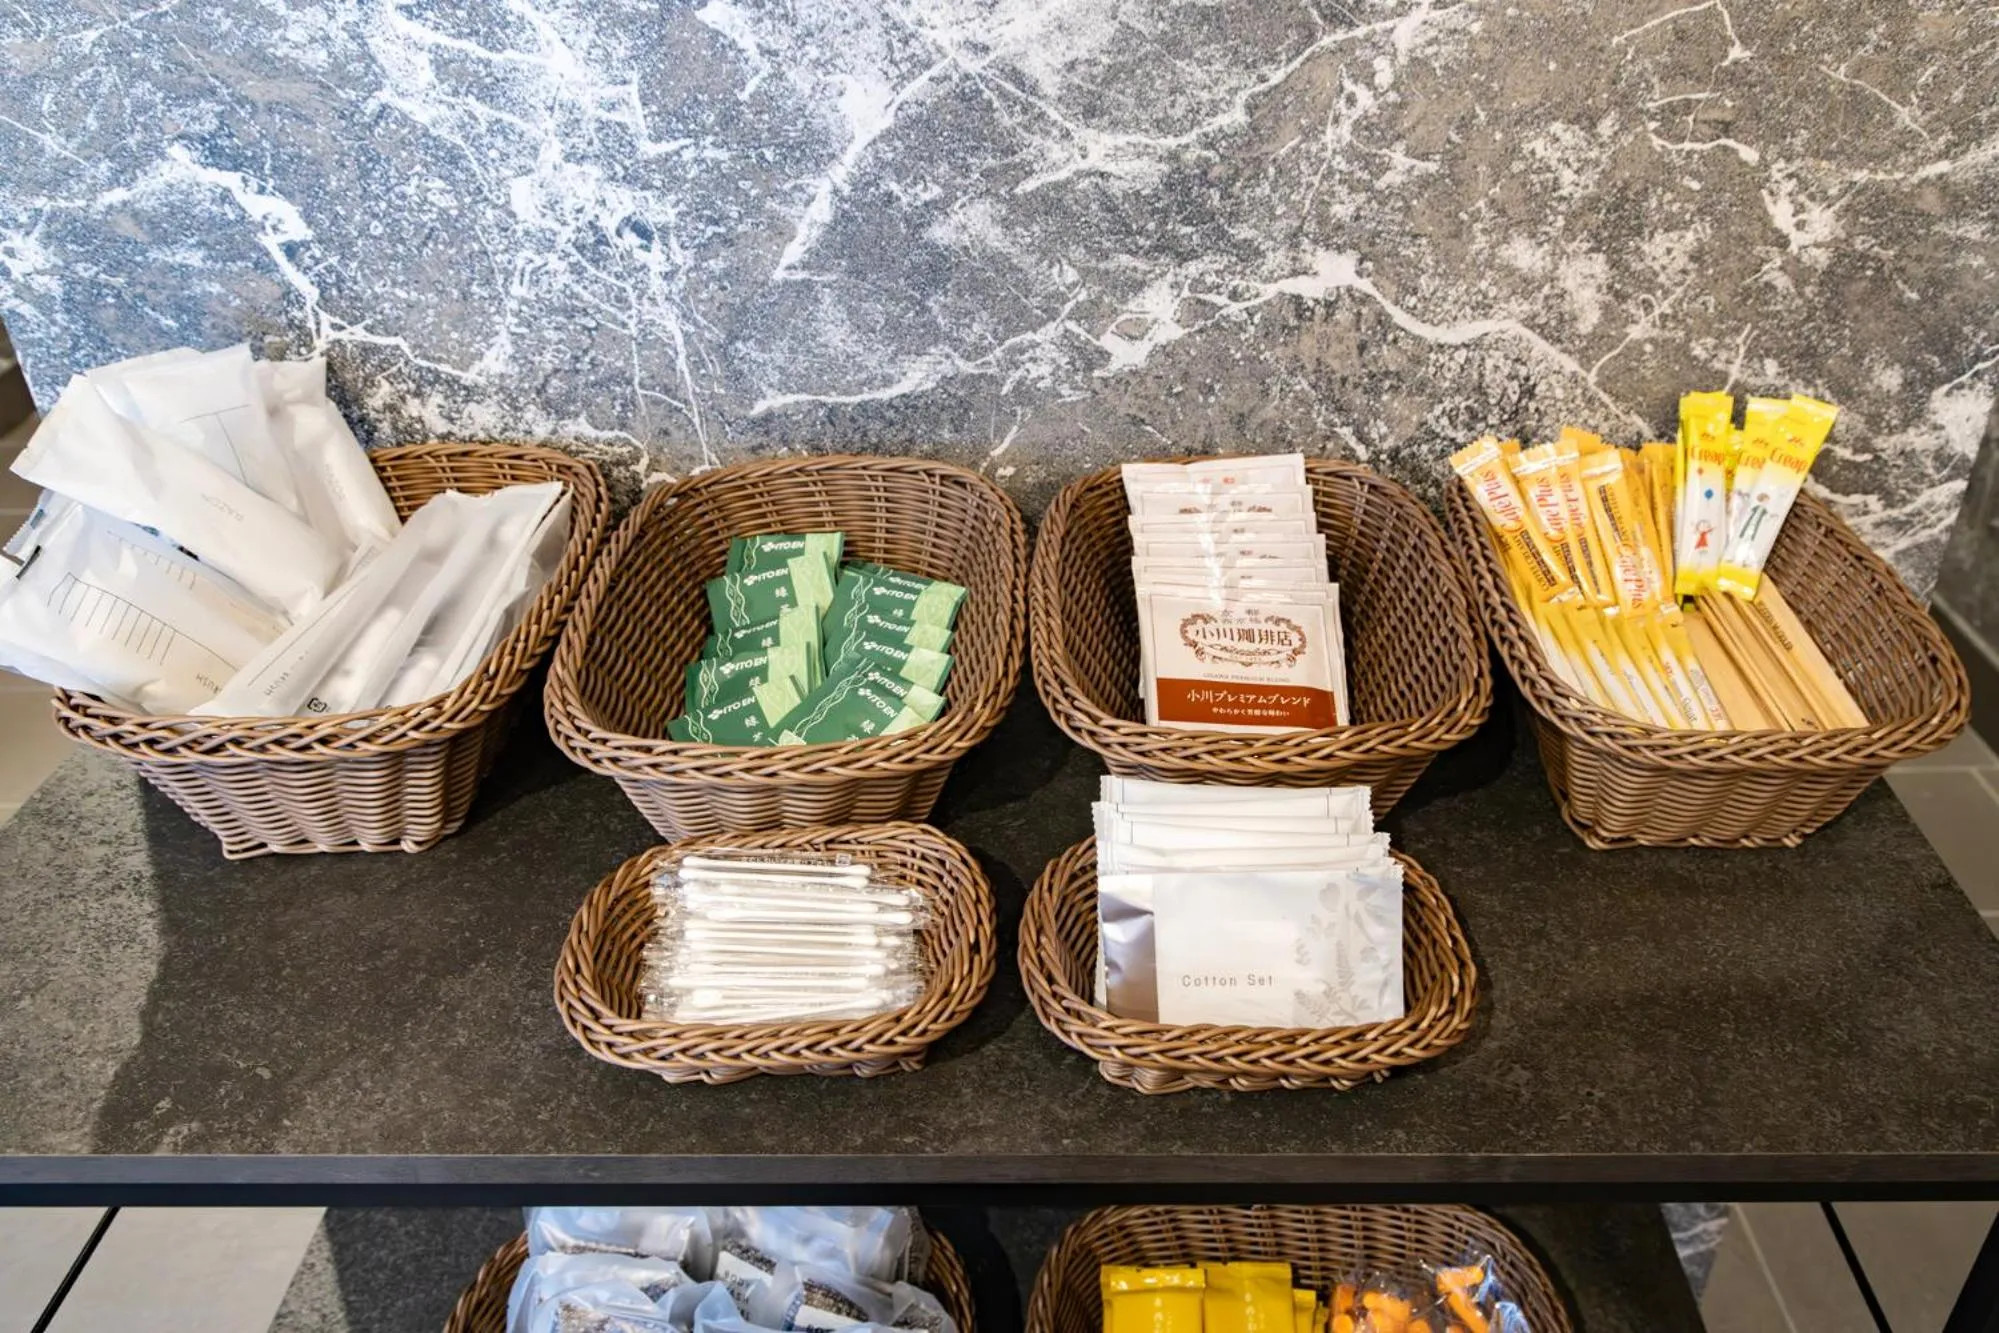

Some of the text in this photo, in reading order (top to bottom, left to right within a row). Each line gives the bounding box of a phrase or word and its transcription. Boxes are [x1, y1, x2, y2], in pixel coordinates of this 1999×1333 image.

[1770, 448, 1809, 474] Creap
[1482, 469, 1509, 502] Plus
[1535, 476, 1559, 508] Plus
[757, 567, 789, 581] ITO EN
[887, 589, 918, 601] ITO EN
[878, 644, 909, 661] ITO EN
[735, 656, 768, 671] ITO EN
[877, 674, 909, 697] ITO EN
[723, 696, 756, 714] ITO EN
[867, 693, 898, 718] ITO EN
[1186, 688, 1312, 708] 小川プレミアムブレンド
[1182, 973, 1273, 988] Cotton Set
